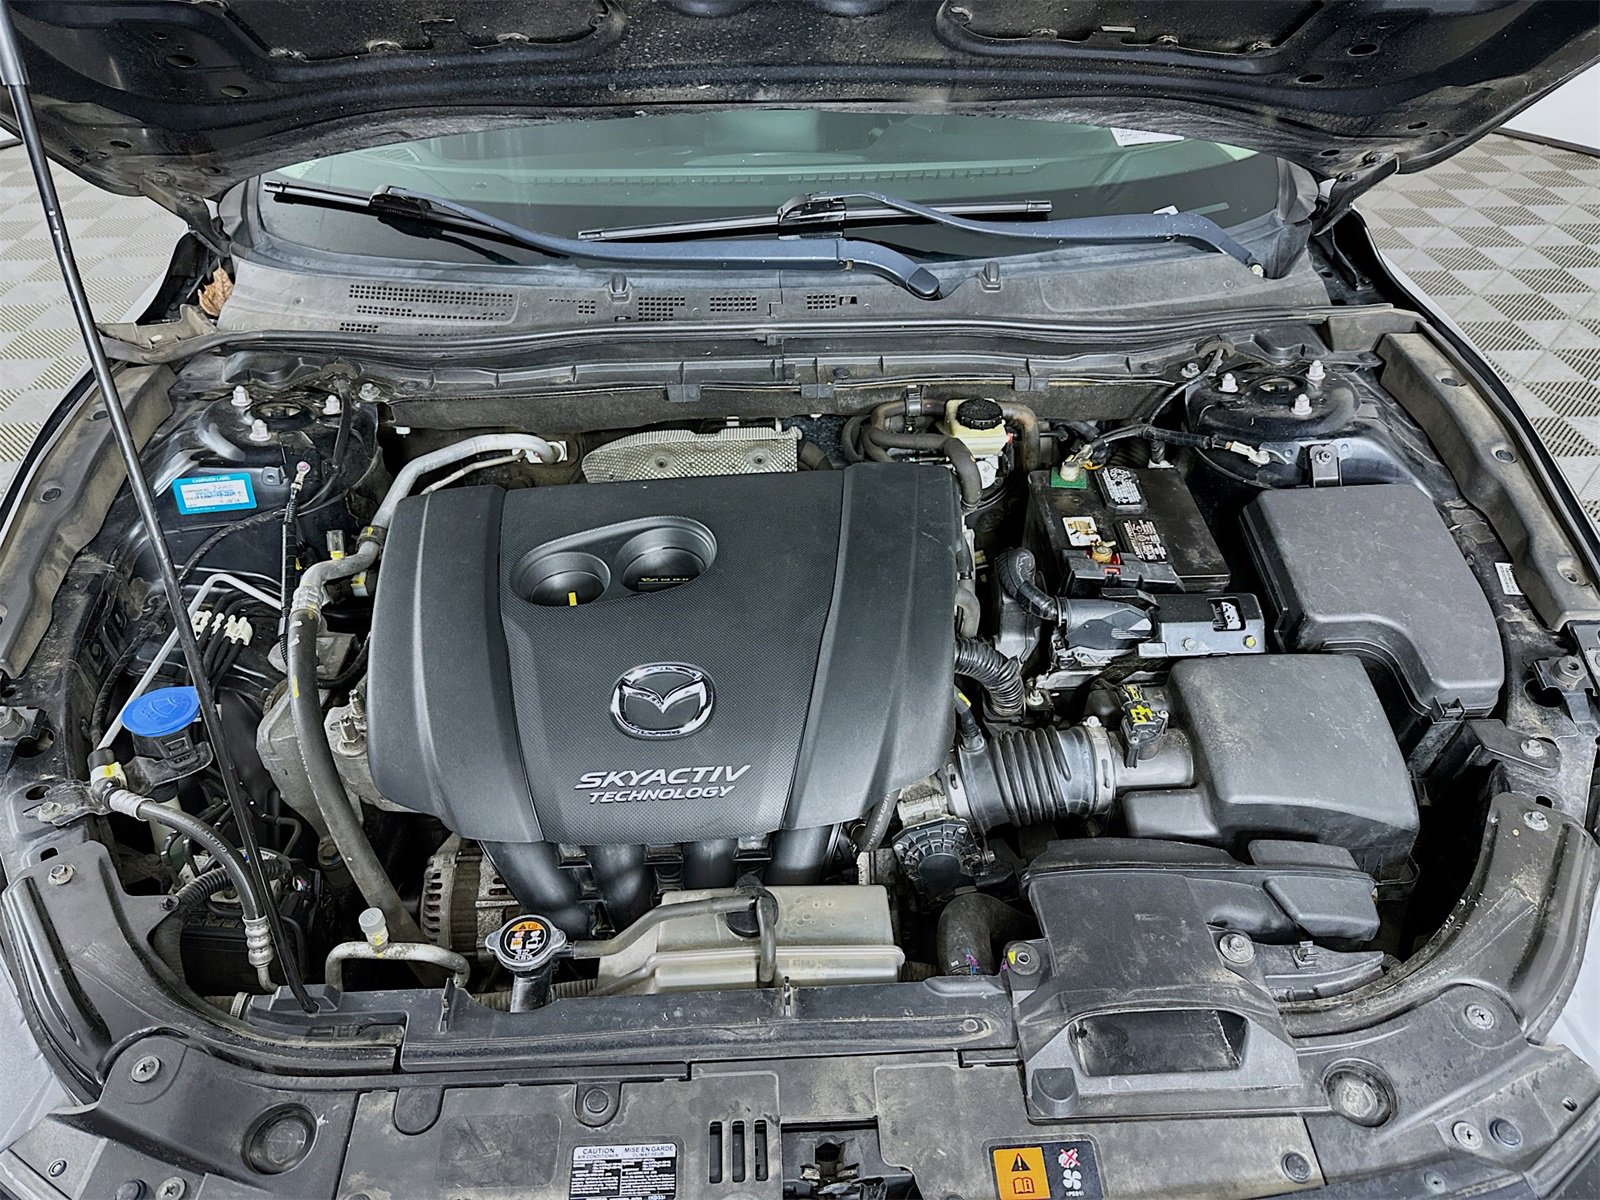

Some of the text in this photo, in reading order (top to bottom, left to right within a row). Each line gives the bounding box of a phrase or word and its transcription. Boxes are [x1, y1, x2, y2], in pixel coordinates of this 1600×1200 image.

[574, 764, 751, 790] SKYACTIV
[589, 785, 736, 804] TECHNOLOGY
[582, 1147, 615, 1155] CAUTION
